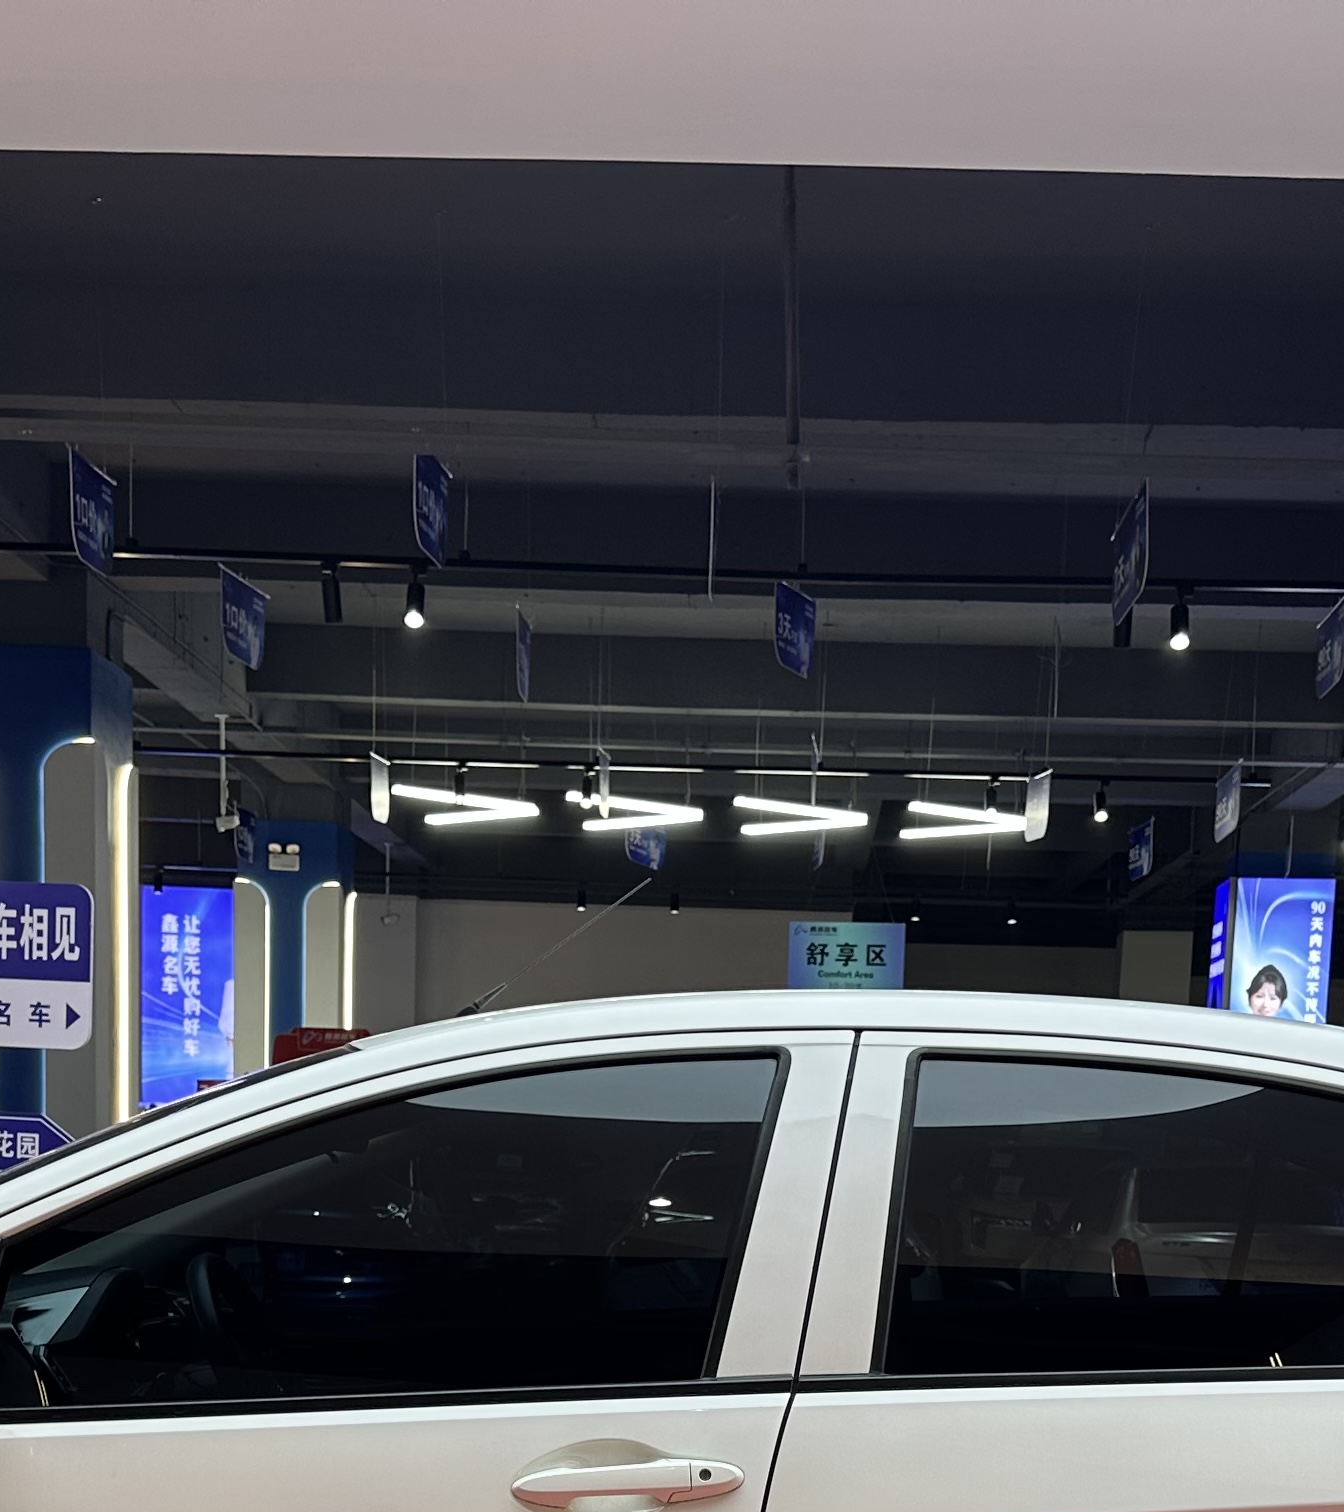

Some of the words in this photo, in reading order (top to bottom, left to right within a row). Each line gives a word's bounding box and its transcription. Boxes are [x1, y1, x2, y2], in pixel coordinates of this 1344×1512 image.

[161, 913, 180, 996] 鑫源名车
[806, 942, 887, 967] 舒享区
[817, 969, 853, 979] Comfort
[854, 970, 874, 980] Area
[183, 914, 202, 1057] 让您无忧购好车
